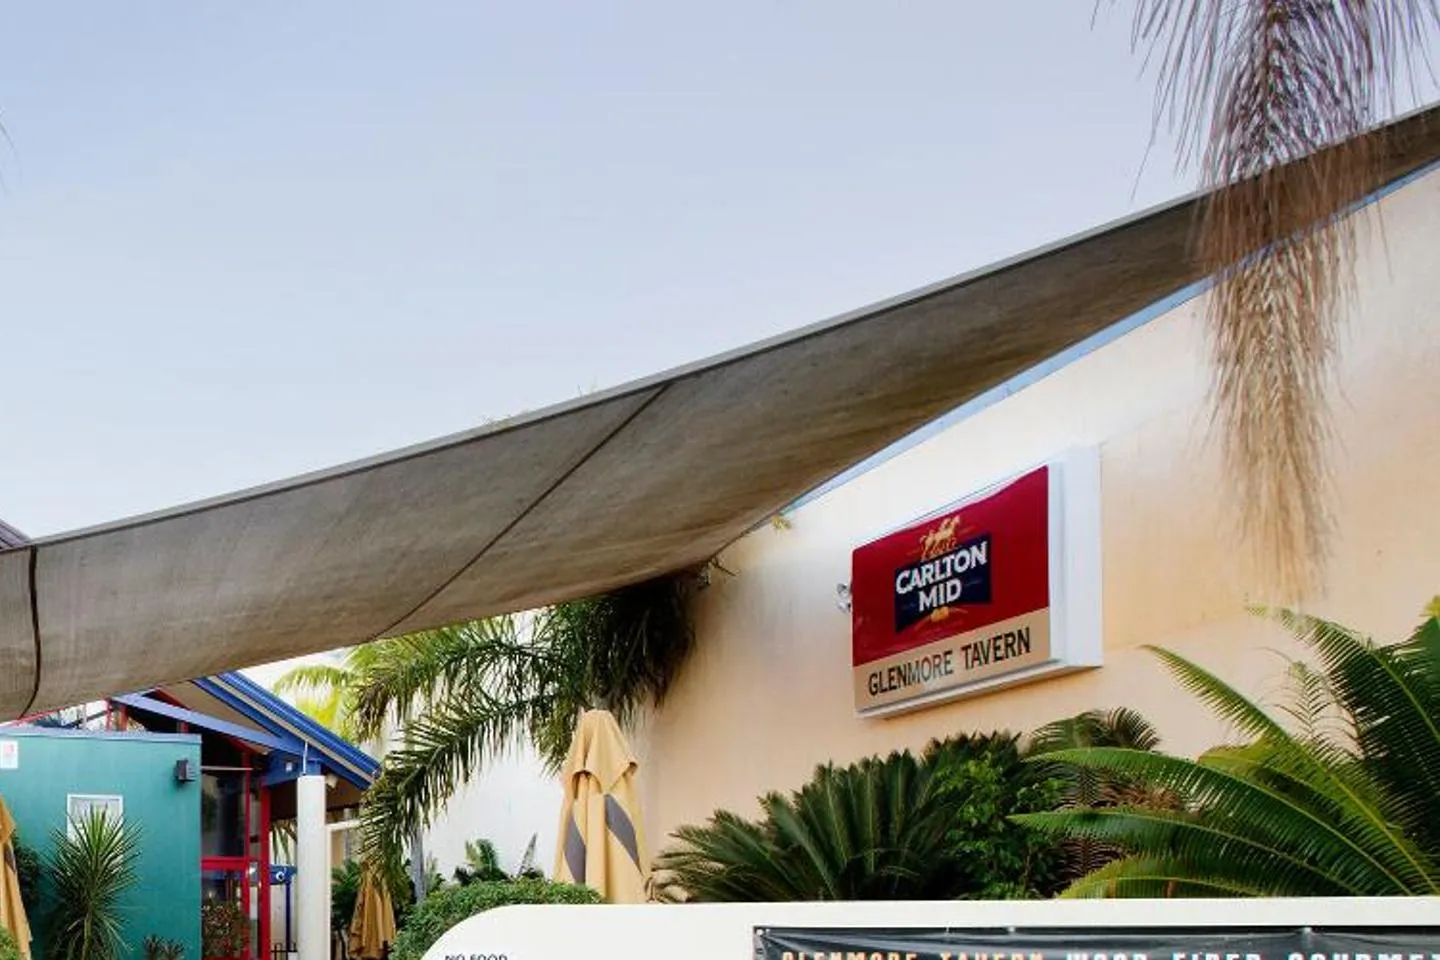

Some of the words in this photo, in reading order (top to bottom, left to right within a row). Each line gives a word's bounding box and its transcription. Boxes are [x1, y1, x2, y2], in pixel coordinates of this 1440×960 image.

[895, 541, 988, 594] CARLTON
[918, 578, 962, 611] MID
[868, 650, 954, 697] GLENMORE
[961, 626, 1032, 670] TAVERN
